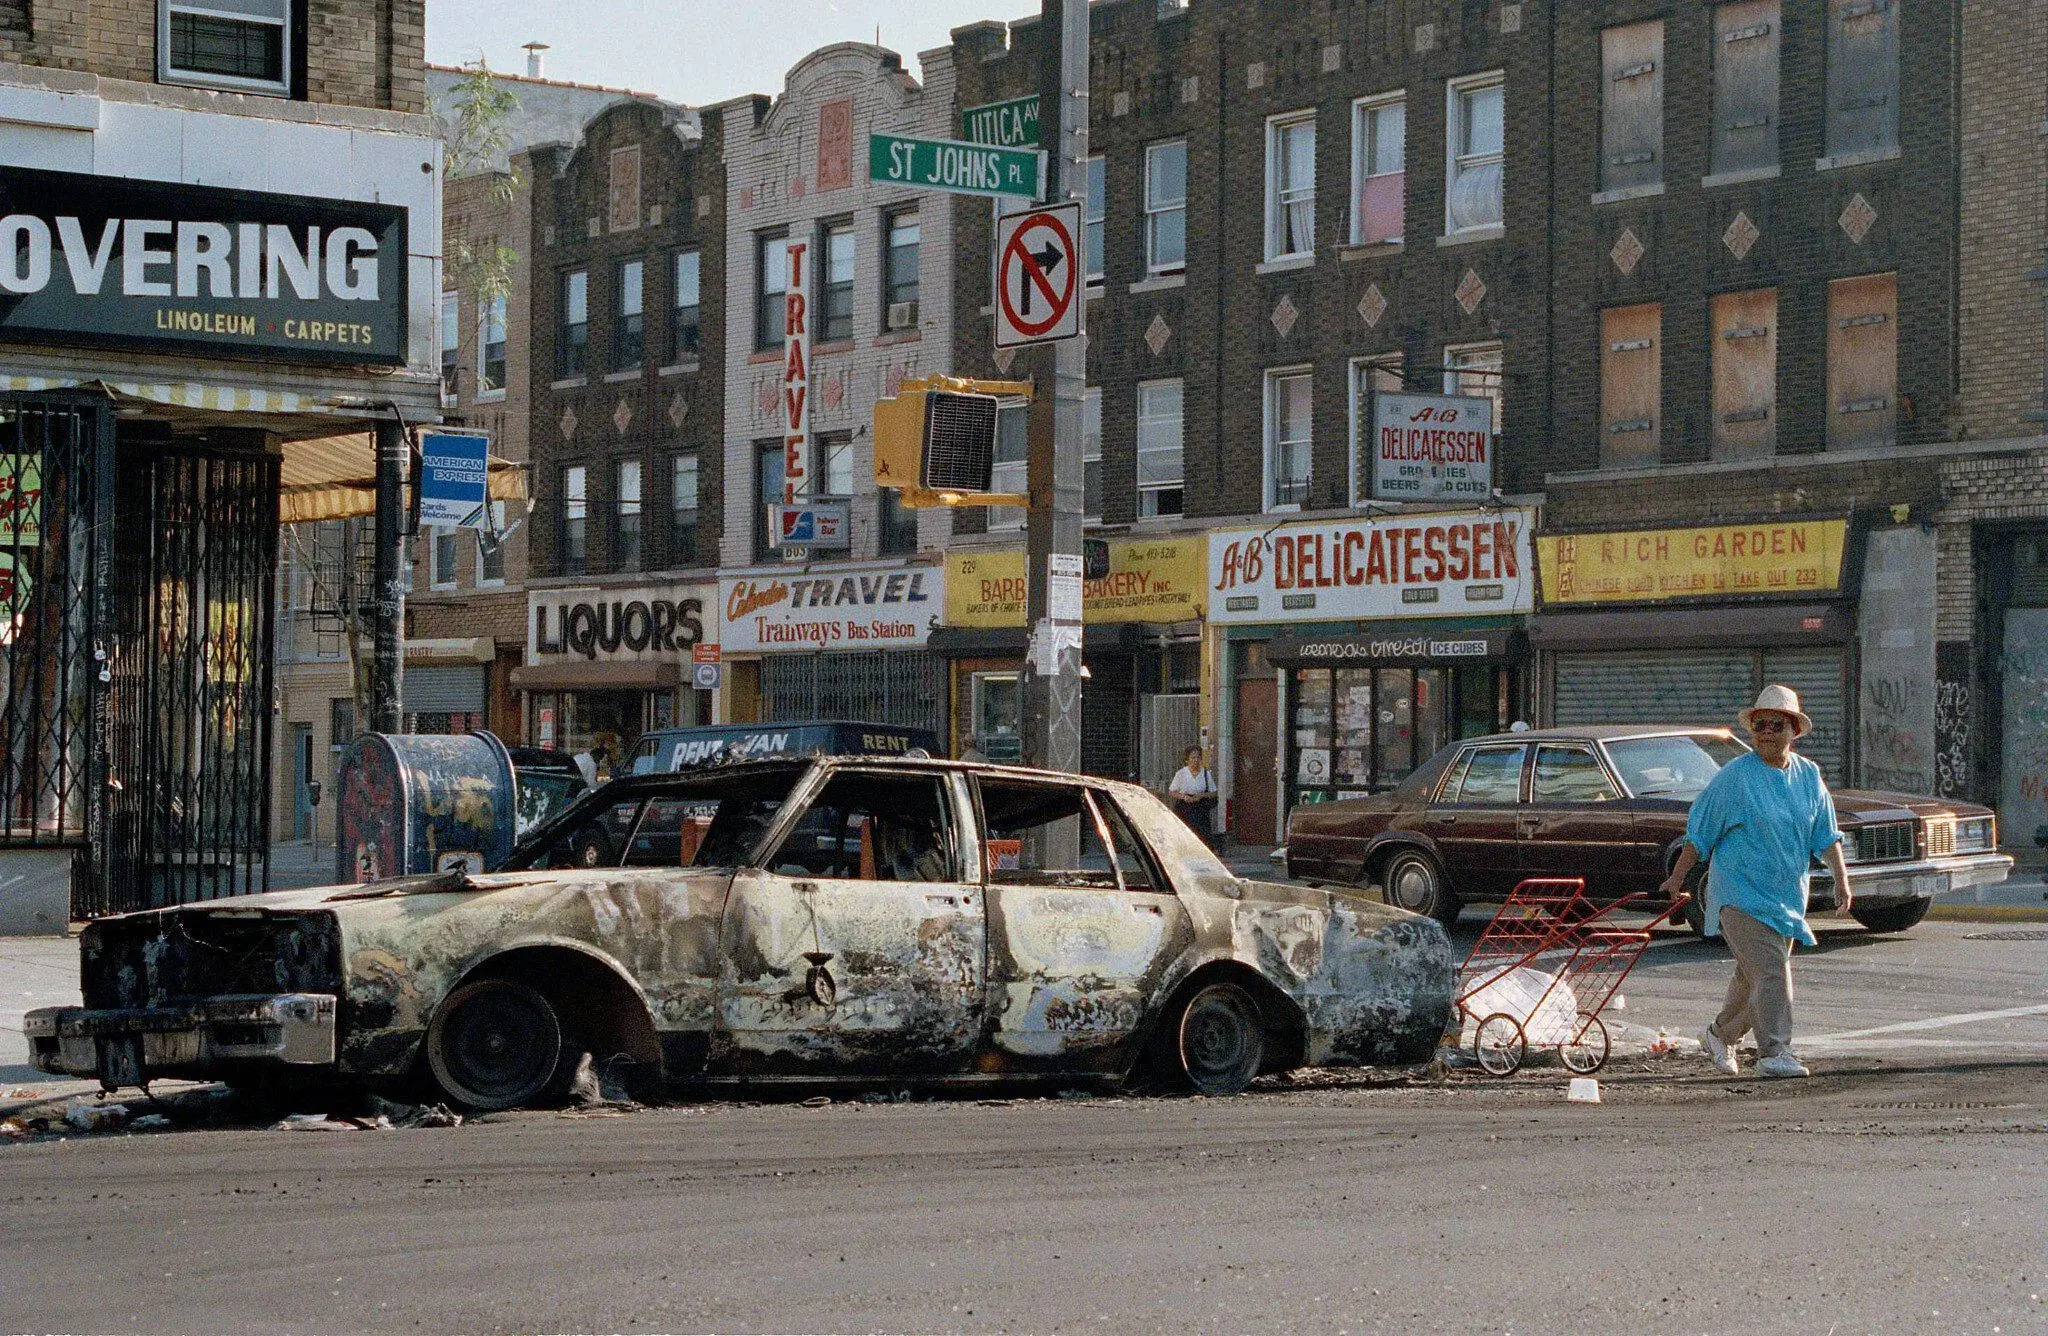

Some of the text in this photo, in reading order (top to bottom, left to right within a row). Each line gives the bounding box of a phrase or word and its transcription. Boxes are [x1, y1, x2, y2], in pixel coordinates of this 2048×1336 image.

[971, 105, 1026, 146] UTICA
[888, 141, 1024, 190] ST JOHNS PL
[0, 213, 380, 301] OVERING
[156, 308, 373, 344] LINOLEUM CARPETS
[1381, 427, 1486, 463] DELICATESSEN
[423, 456, 483, 470] AMERICAN
[433, 469, 486, 484] EXPRESS
[1382, 479, 1421, 490] BEERS
[1456, 481, 1487, 492] CUTS
[420, 501, 447, 511] Cards
[1600, 527, 1806, 563] RICH GARDEN
[1082, 570, 1152, 599] BAKERY
[1732, 570, 1760, 585] TAKE
[1767, 569, 1788, 584] OUT
[1795, 568, 1817, 582] 233
[790, 573, 929, 608] TRAVEL
[536, 599, 704, 660] LIQUORS
[847, 620, 869, 639] Bus
[871, 619, 916, 639] Station
[1433, 642, 1450, 654] ICE
[1452, 641, 1484, 653] CUBES
[862, 734, 909, 751] RENT
